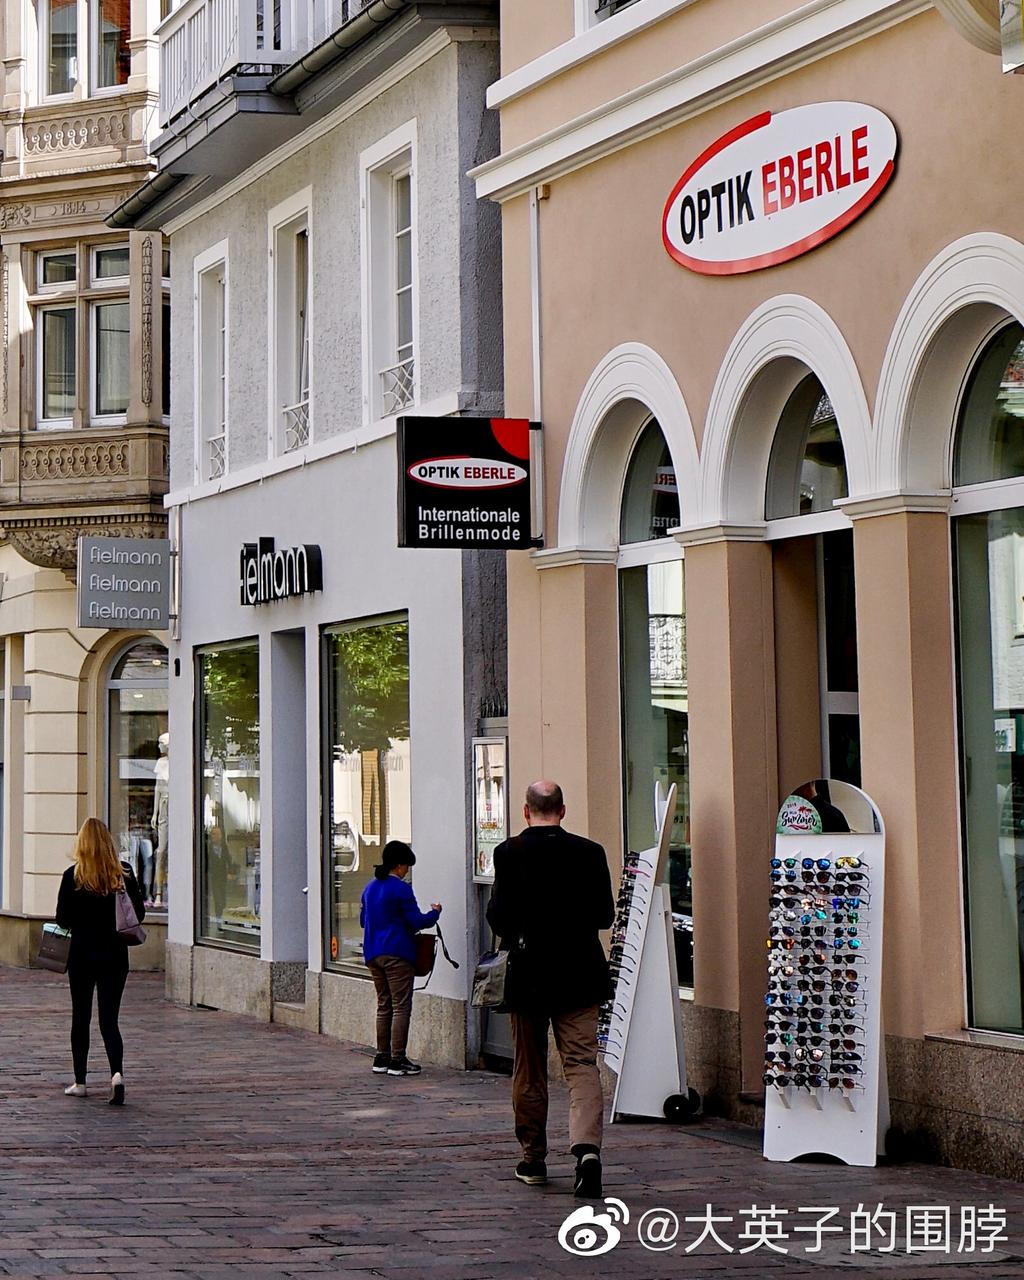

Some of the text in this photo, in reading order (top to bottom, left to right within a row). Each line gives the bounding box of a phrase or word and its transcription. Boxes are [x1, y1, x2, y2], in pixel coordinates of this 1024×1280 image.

[680, 124, 869, 245] OPTIK EBERLE
[418, 466, 516, 480] OPTIK EBERLE
[418, 506, 520, 523] Internationale
[418, 524, 521, 541] Brillenmode
[90, 546, 162, 565] fielmann
[89, 573, 161, 593] fielmann
[89, 601, 161, 620] fielmann
